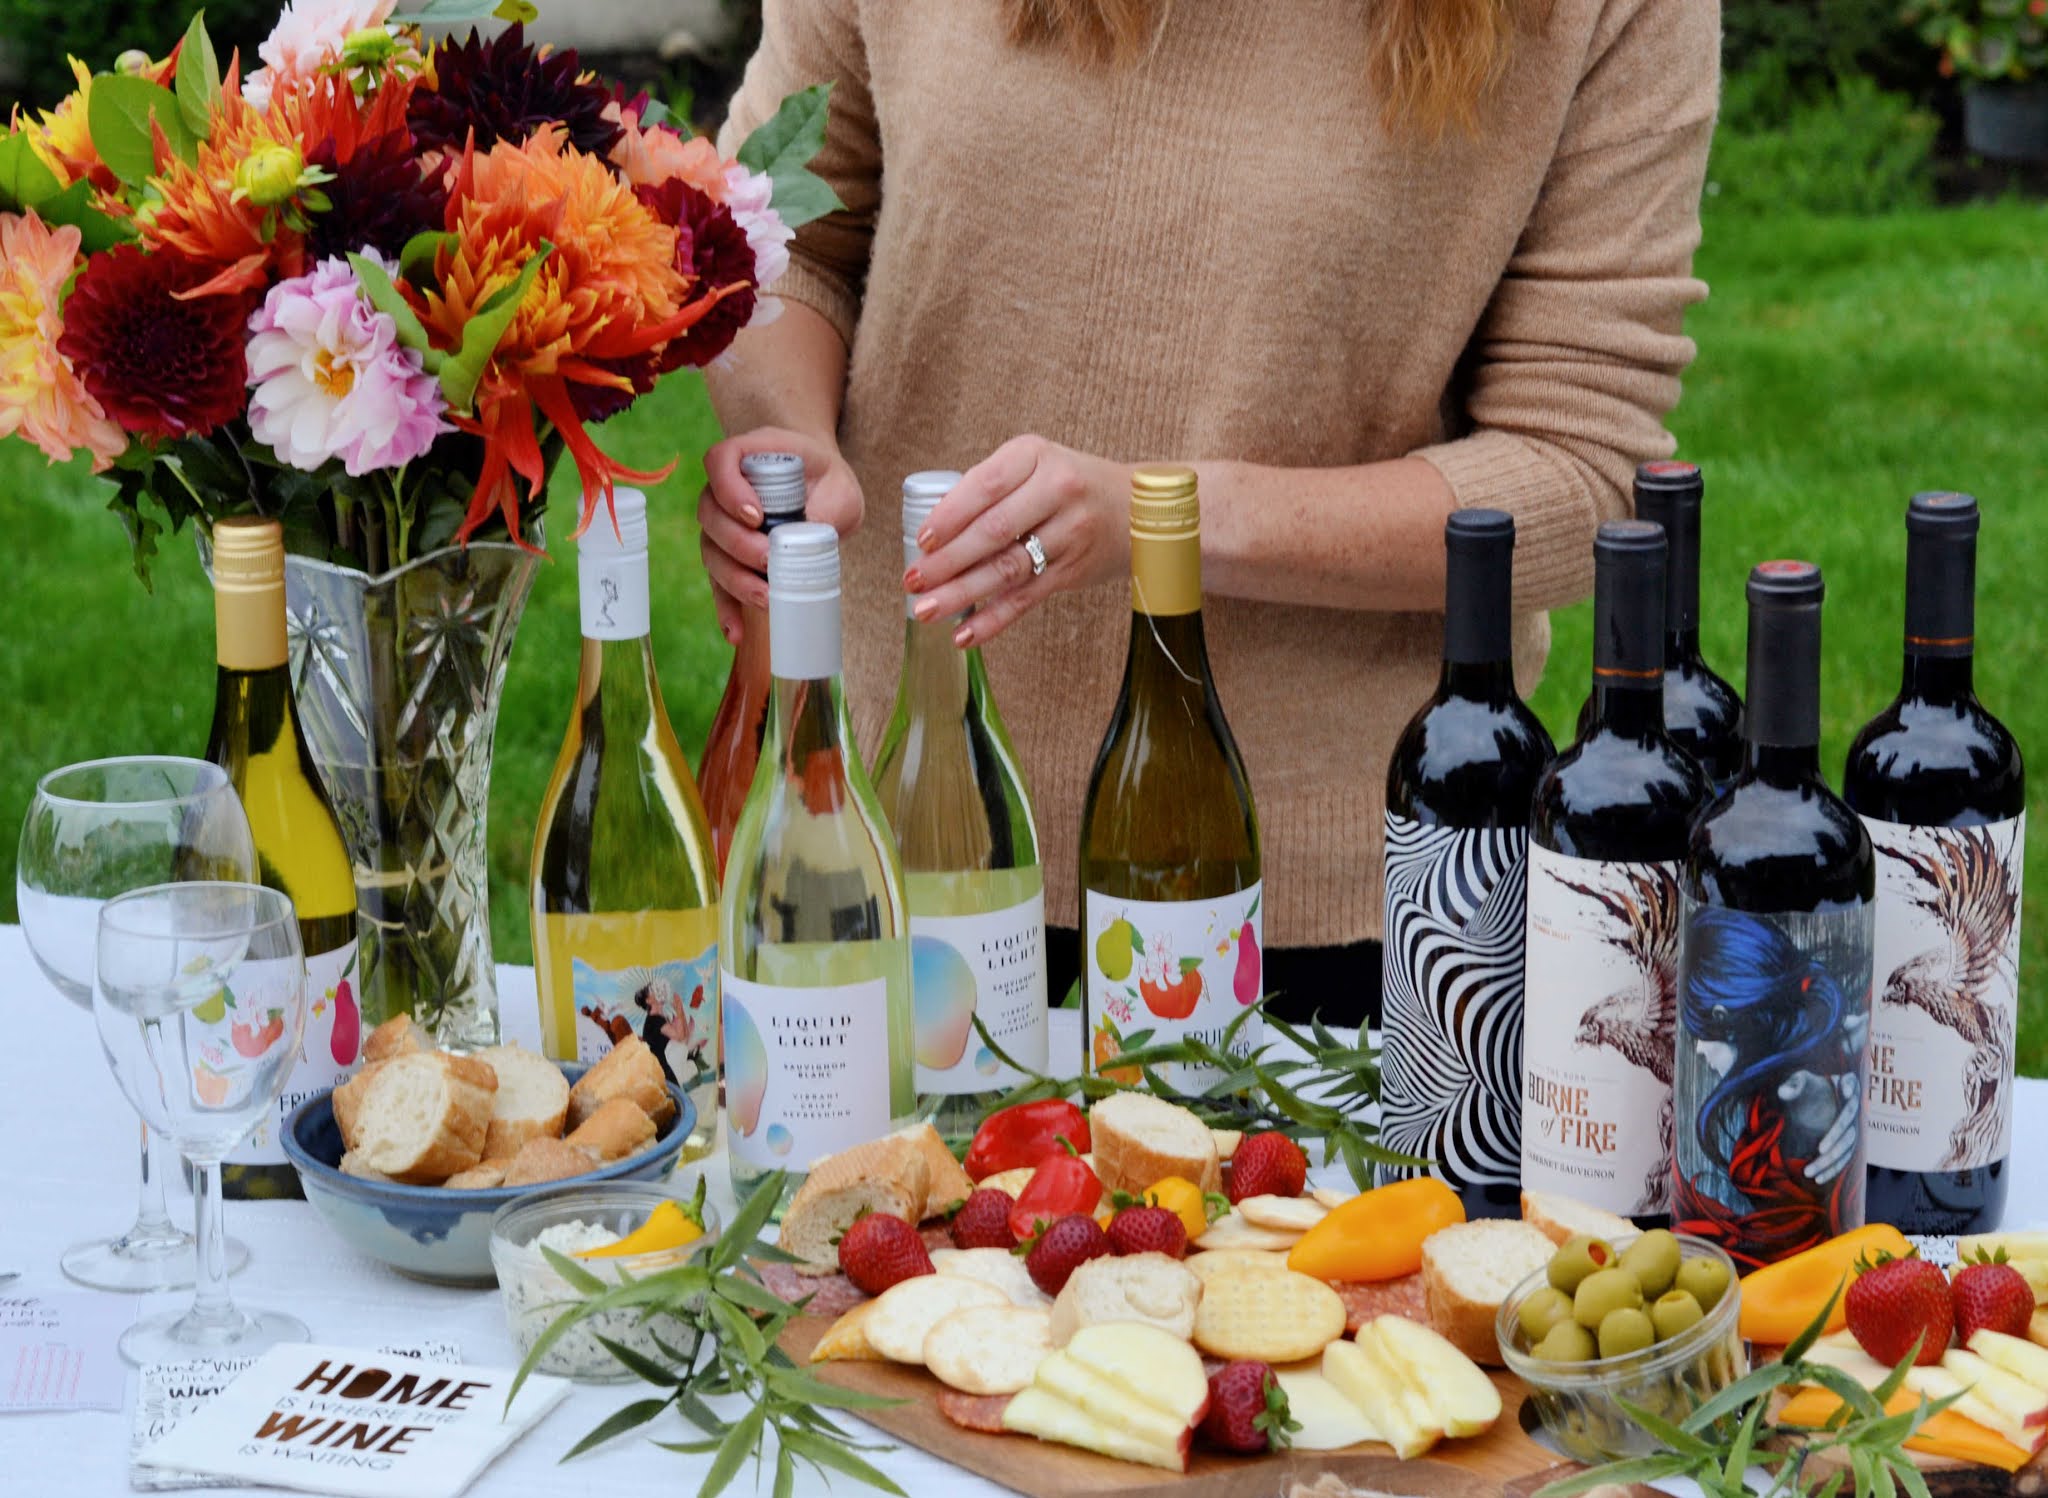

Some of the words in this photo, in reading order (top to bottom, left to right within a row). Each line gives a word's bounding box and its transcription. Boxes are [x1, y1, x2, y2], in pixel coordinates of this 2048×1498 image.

[982, 925, 1038, 953] LIQUID
[988, 944, 1035, 970] LIGHT
[772, 1016, 852, 1032] LIQUID
[779, 1034, 848, 1047] LIGHT
[784, 1063, 846, 1071] SAUVIGNON
[1528, 1070, 1589, 1117] BORNE
[1868, 1074, 1922, 1111] FIRE
[1541, 1118, 1555, 1138] of
[1560, 1116, 1617, 1155] FIRE
[1560, 1164, 1616, 1180] SAUVIGNON
[293, 1360, 492, 1411] HOME
[275, 1396, 296, 1409] IS
[309, 1400, 403, 1421] WHERE
[413, 1409, 464, 1424] THE
[254, 1411, 435, 1454] WINE
[238, 1444, 260, 1456] IS
[273, 1447, 395, 1471] WAITING
